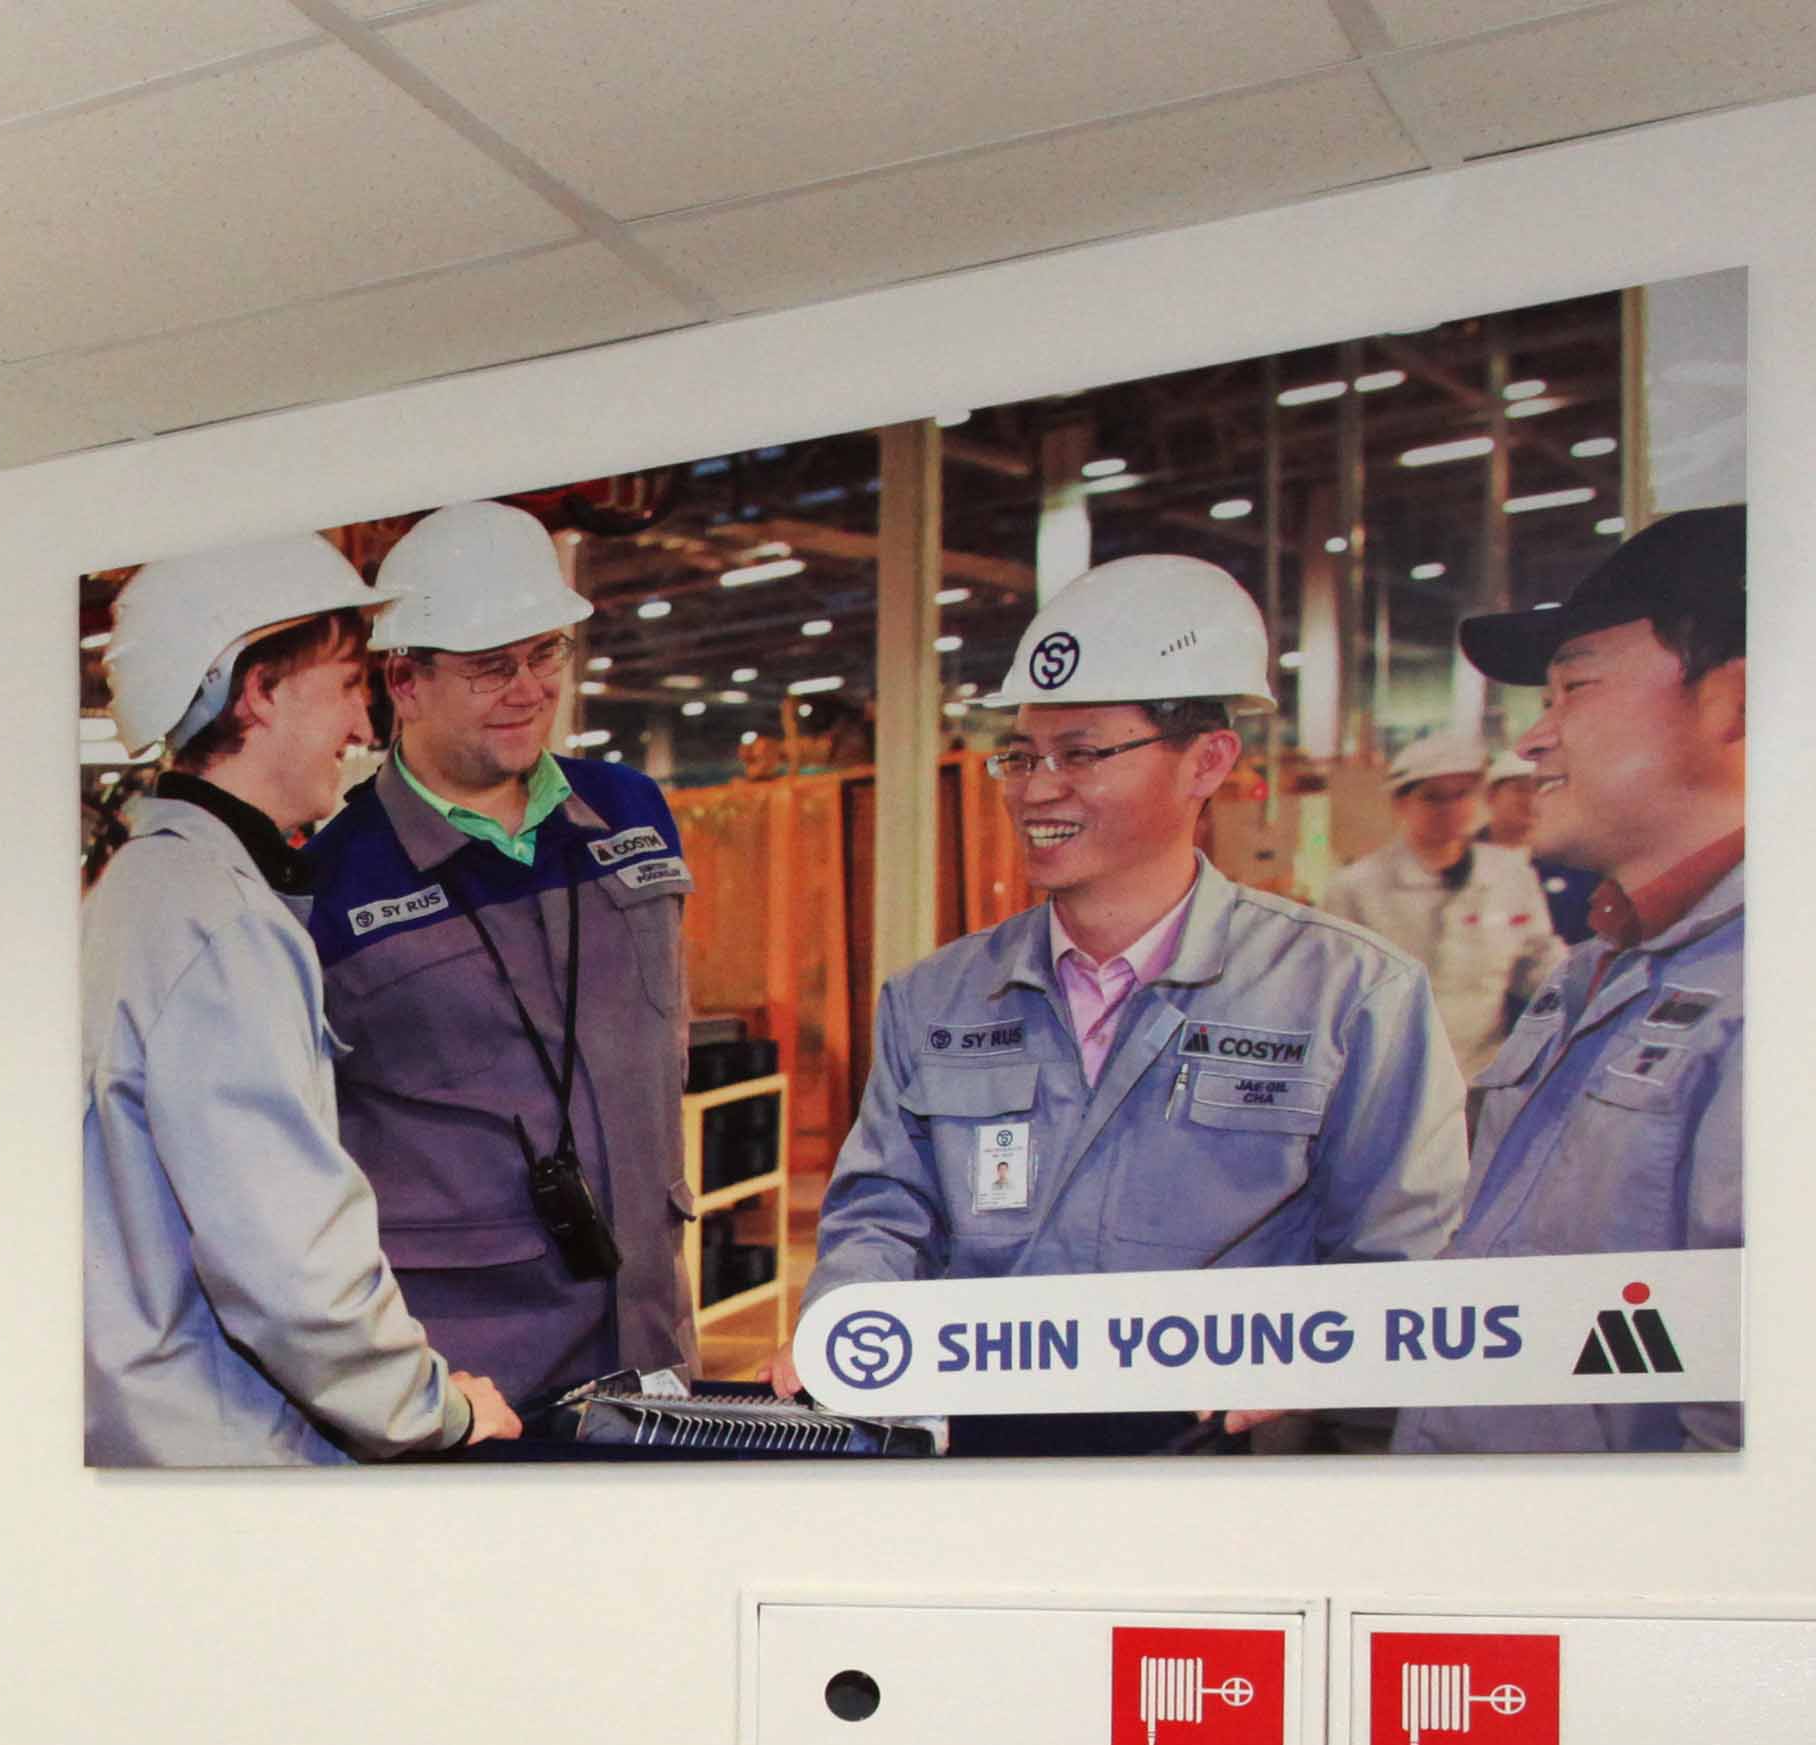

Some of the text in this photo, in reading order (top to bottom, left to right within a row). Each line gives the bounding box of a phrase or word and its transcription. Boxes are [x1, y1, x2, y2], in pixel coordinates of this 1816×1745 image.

[381, 892, 442, 918] SY RUS
[961, 1026, 1023, 1049] SY RUS
[1218, 1036, 1304, 1062] COSYM
[936, 1318, 1079, 1373] SHIN
[1106, 1307, 1355, 1367] YOUNG
[1384, 1304, 1523, 1362] RUS
